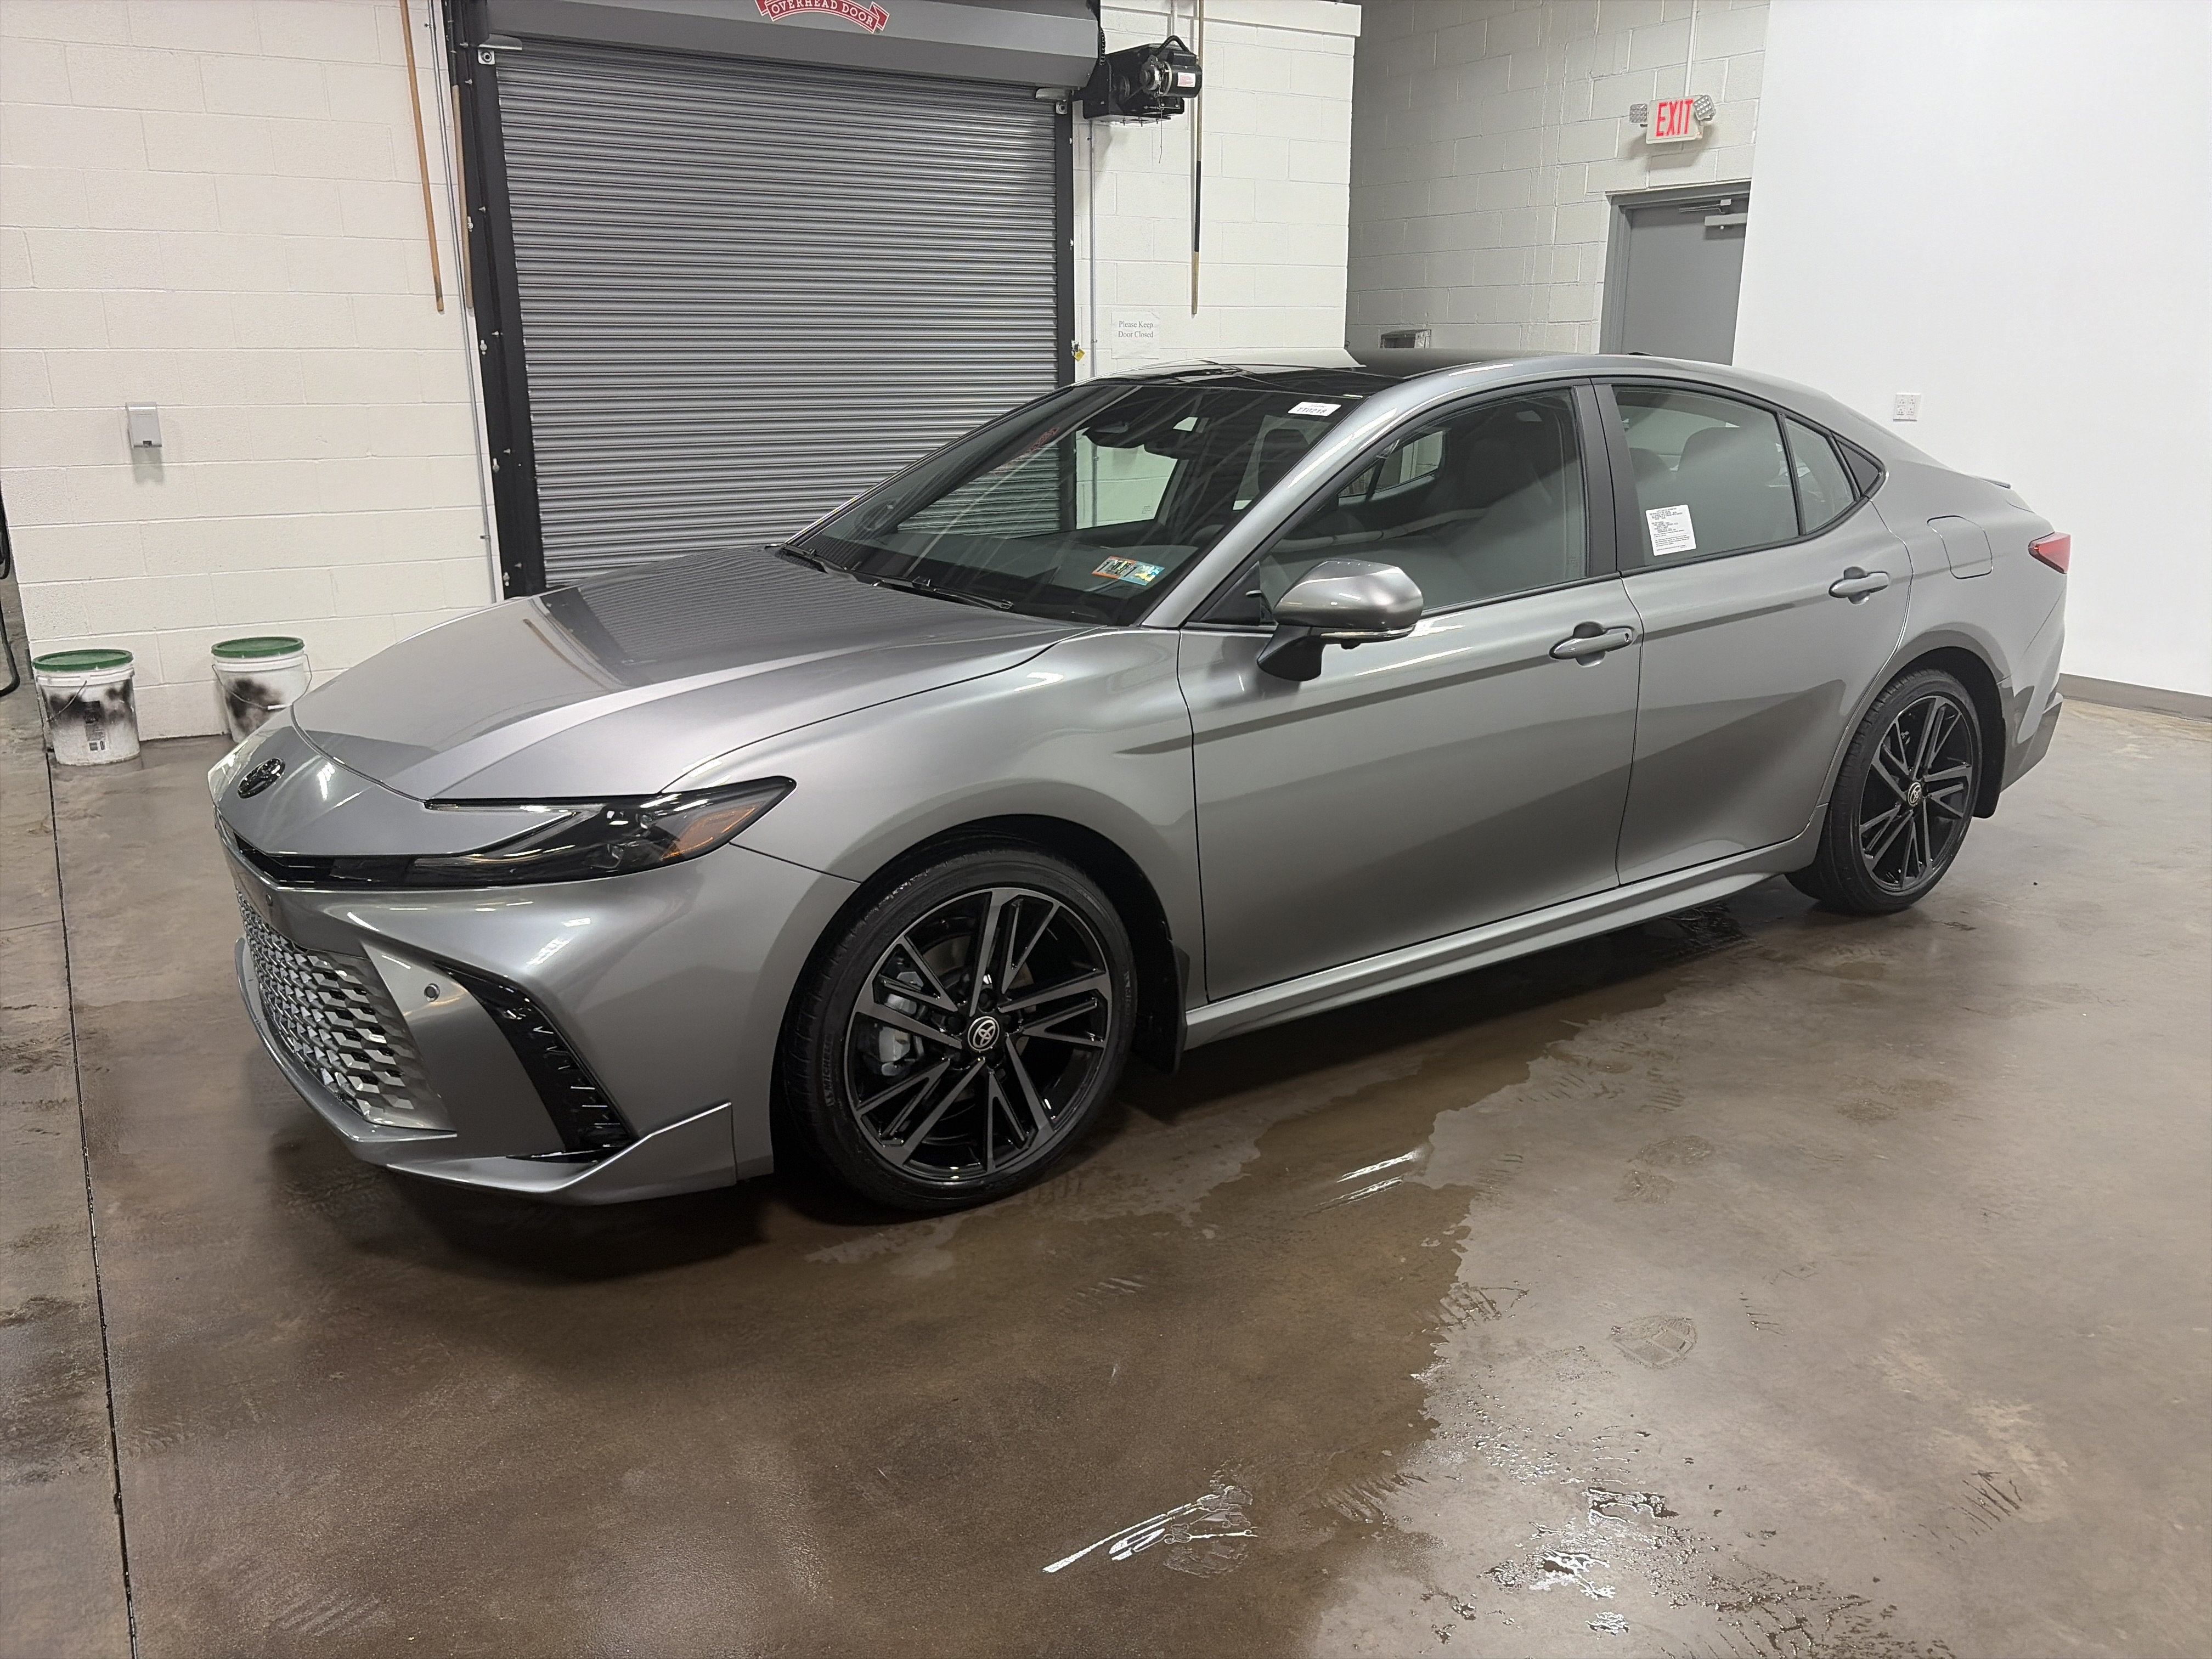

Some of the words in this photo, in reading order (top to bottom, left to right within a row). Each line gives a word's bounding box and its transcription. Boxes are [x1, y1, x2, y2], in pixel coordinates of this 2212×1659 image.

[771, 0, 838, 14] OVERHEAD
[842, 4, 872, 27] DOOR
[1656, 99, 1694, 137] EXIT
[1138, 321, 1153, 329] Keep
